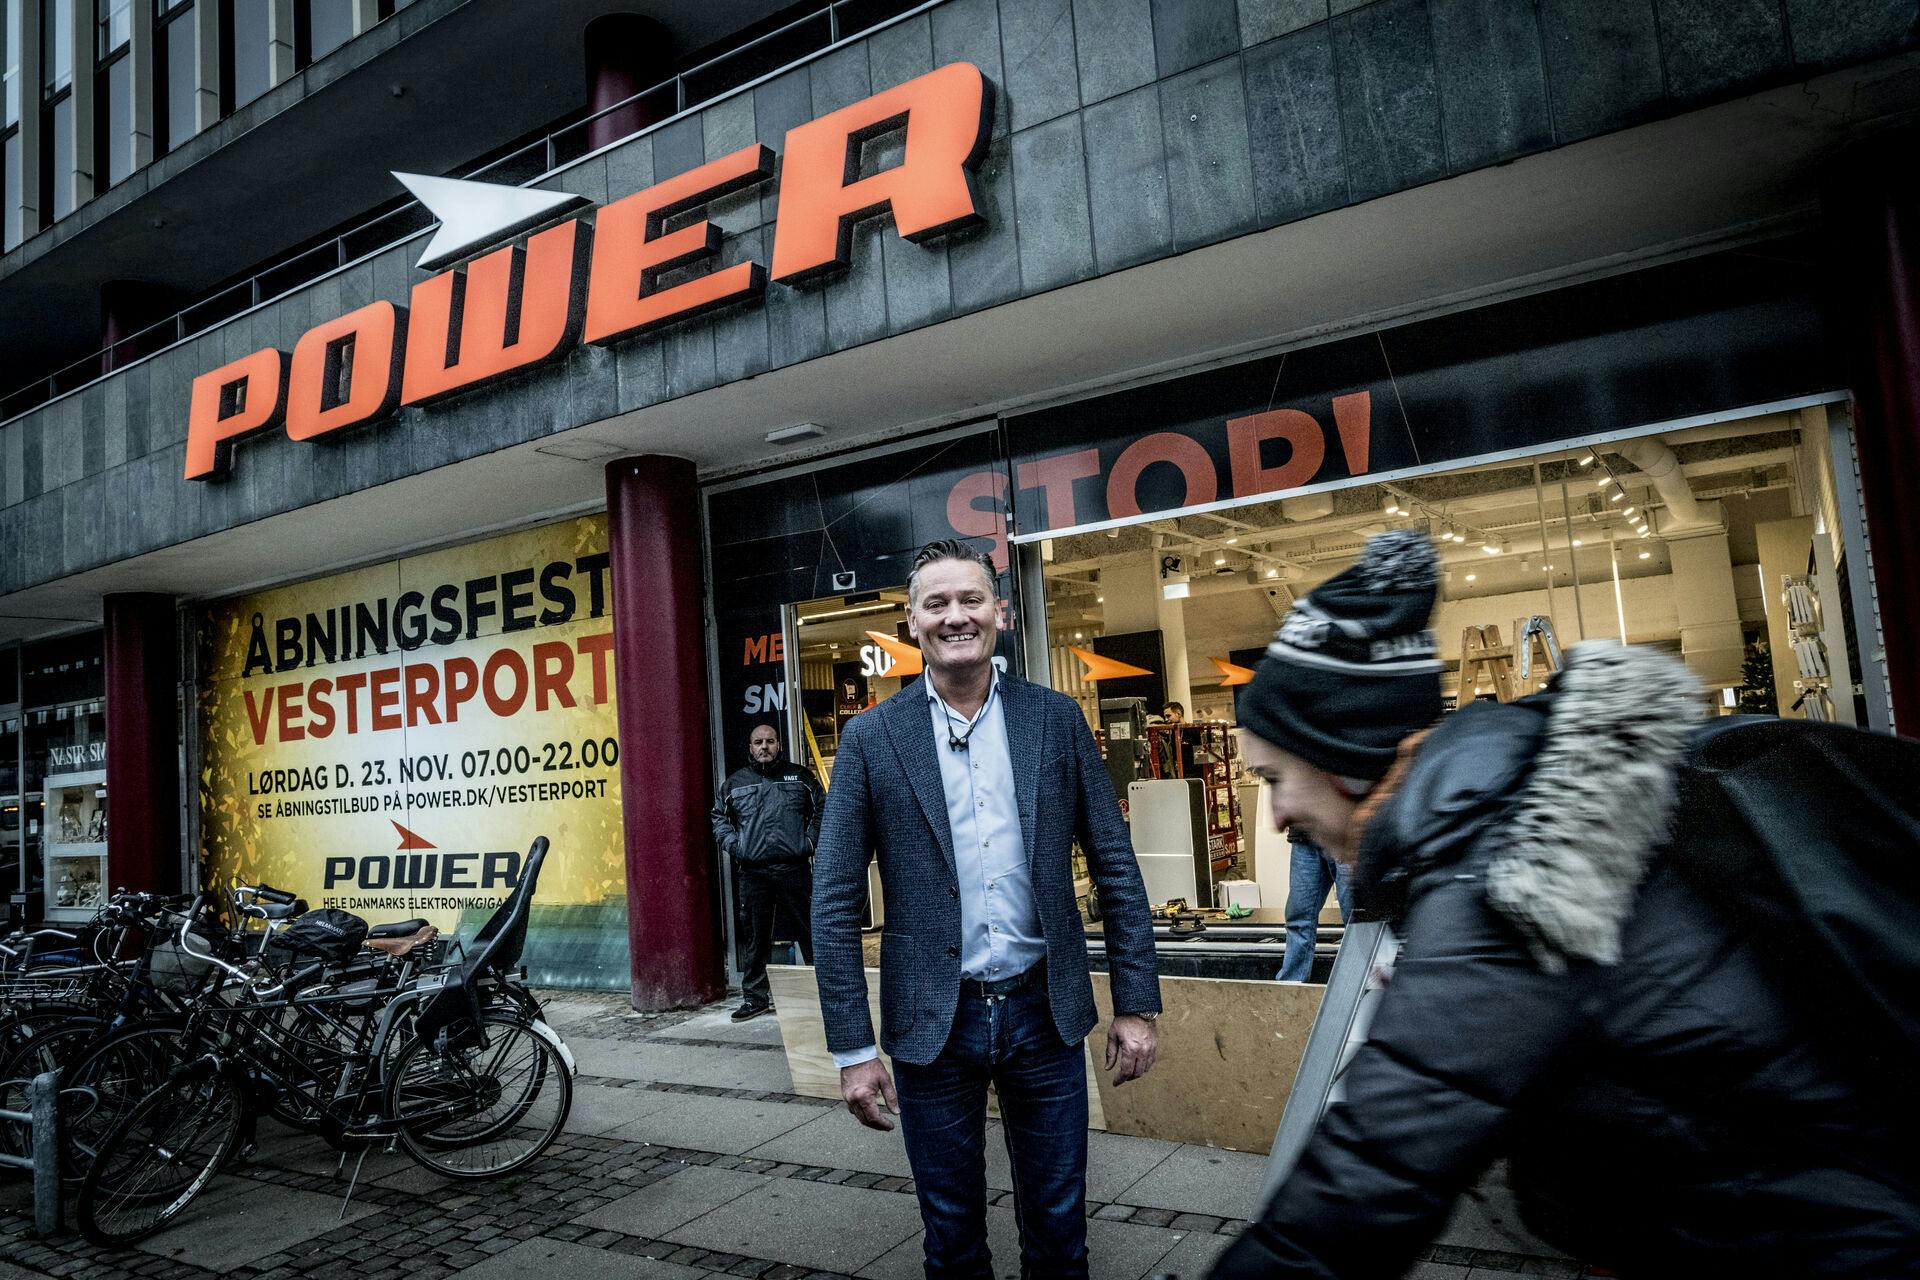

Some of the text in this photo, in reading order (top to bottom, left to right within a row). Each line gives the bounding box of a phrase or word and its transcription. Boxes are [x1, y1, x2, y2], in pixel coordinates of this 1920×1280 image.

[184, 62, 992, 482] POWER
[946, 390, 1372, 574] STOP!
[242, 551, 612, 678] ÅBNINGSFEST
[242, 633, 616, 746] VESTERPORT
[742, 682, 788, 714] SN
[50, 744, 87, 767] NASIR
[248, 737, 619, 796] LØRDAG D. 23. NOV. 07.00-22.00
[257, 778, 608, 819] SE ÅBNINGSTILBUD PÅ POWER.DK/VESTERPORT
[323, 851, 522, 890] POWER
[323, 896, 508, 910] HELE DANMARKS ELEKTRONIKGIGA
